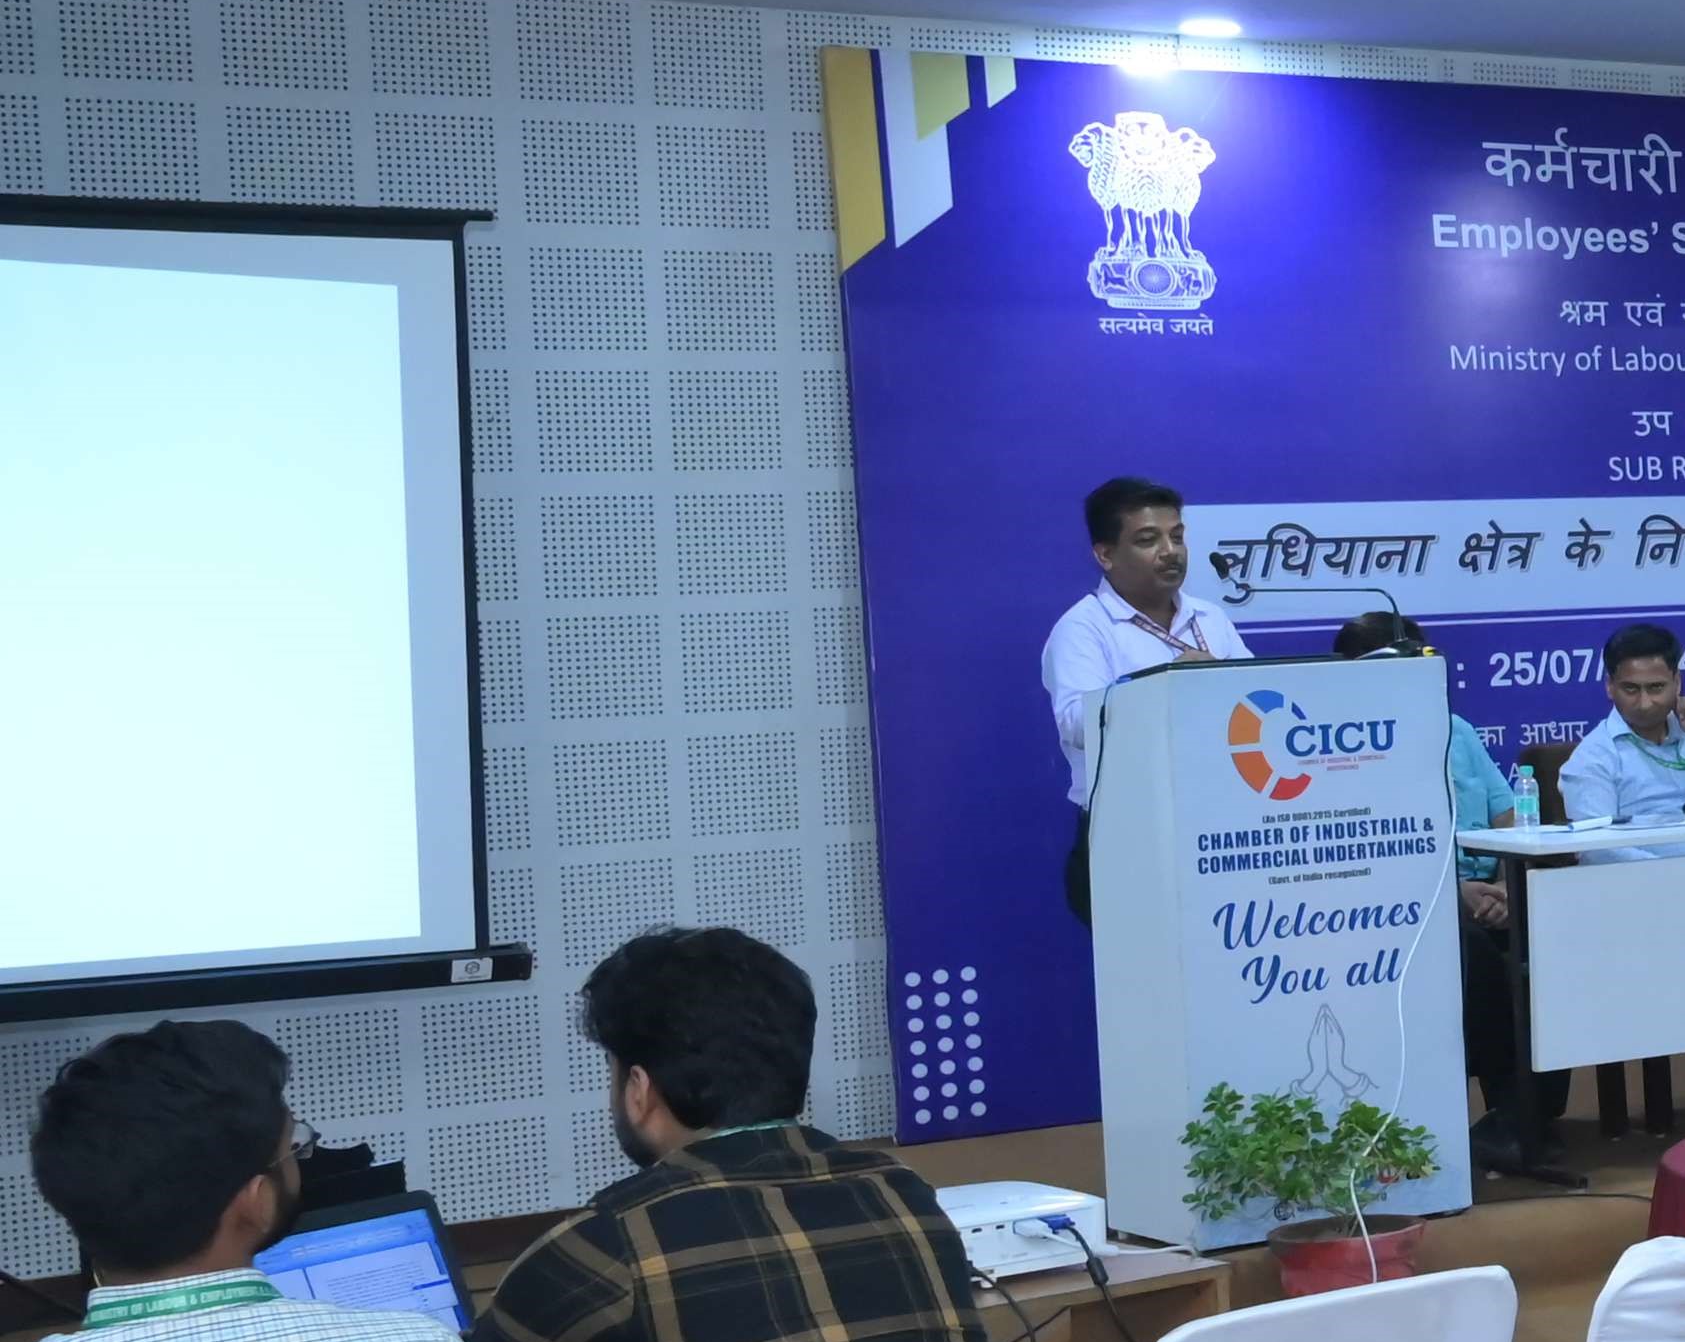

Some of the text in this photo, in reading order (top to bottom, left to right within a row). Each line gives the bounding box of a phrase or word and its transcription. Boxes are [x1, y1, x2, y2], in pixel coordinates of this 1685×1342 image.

[1482, 127, 1683, 195] कर्मचारी
[1098, 312, 1214, 336] सत्यमेव जयते
[1559, 298, 1609, 327] श्रम
[1623, 293, 1666, 328] एवं
[1449, 344, 1567, 378] Ministry
[1574, 345, 1603, 372] of
[1632, 409, 1673, 437] उप
[1608, 455, 1664, 481] SUB
[1217, 521, 1438, 604] लुधियाना
[1458, 518, 1543, 575] क्षेत्र
[1565, 517, 1612, 570] के
[1285, 719, 1397, 758] CICU
[1198, 816, 1434, 852] CHAMBER OF INDUSTRIAL &
[1197, 836, 1437, 875] COMMERCIAL UNDERTAKINGS
[1212, 898, 1422, 951] Welcomes
[1241, 948, 1403, 1005] You all
